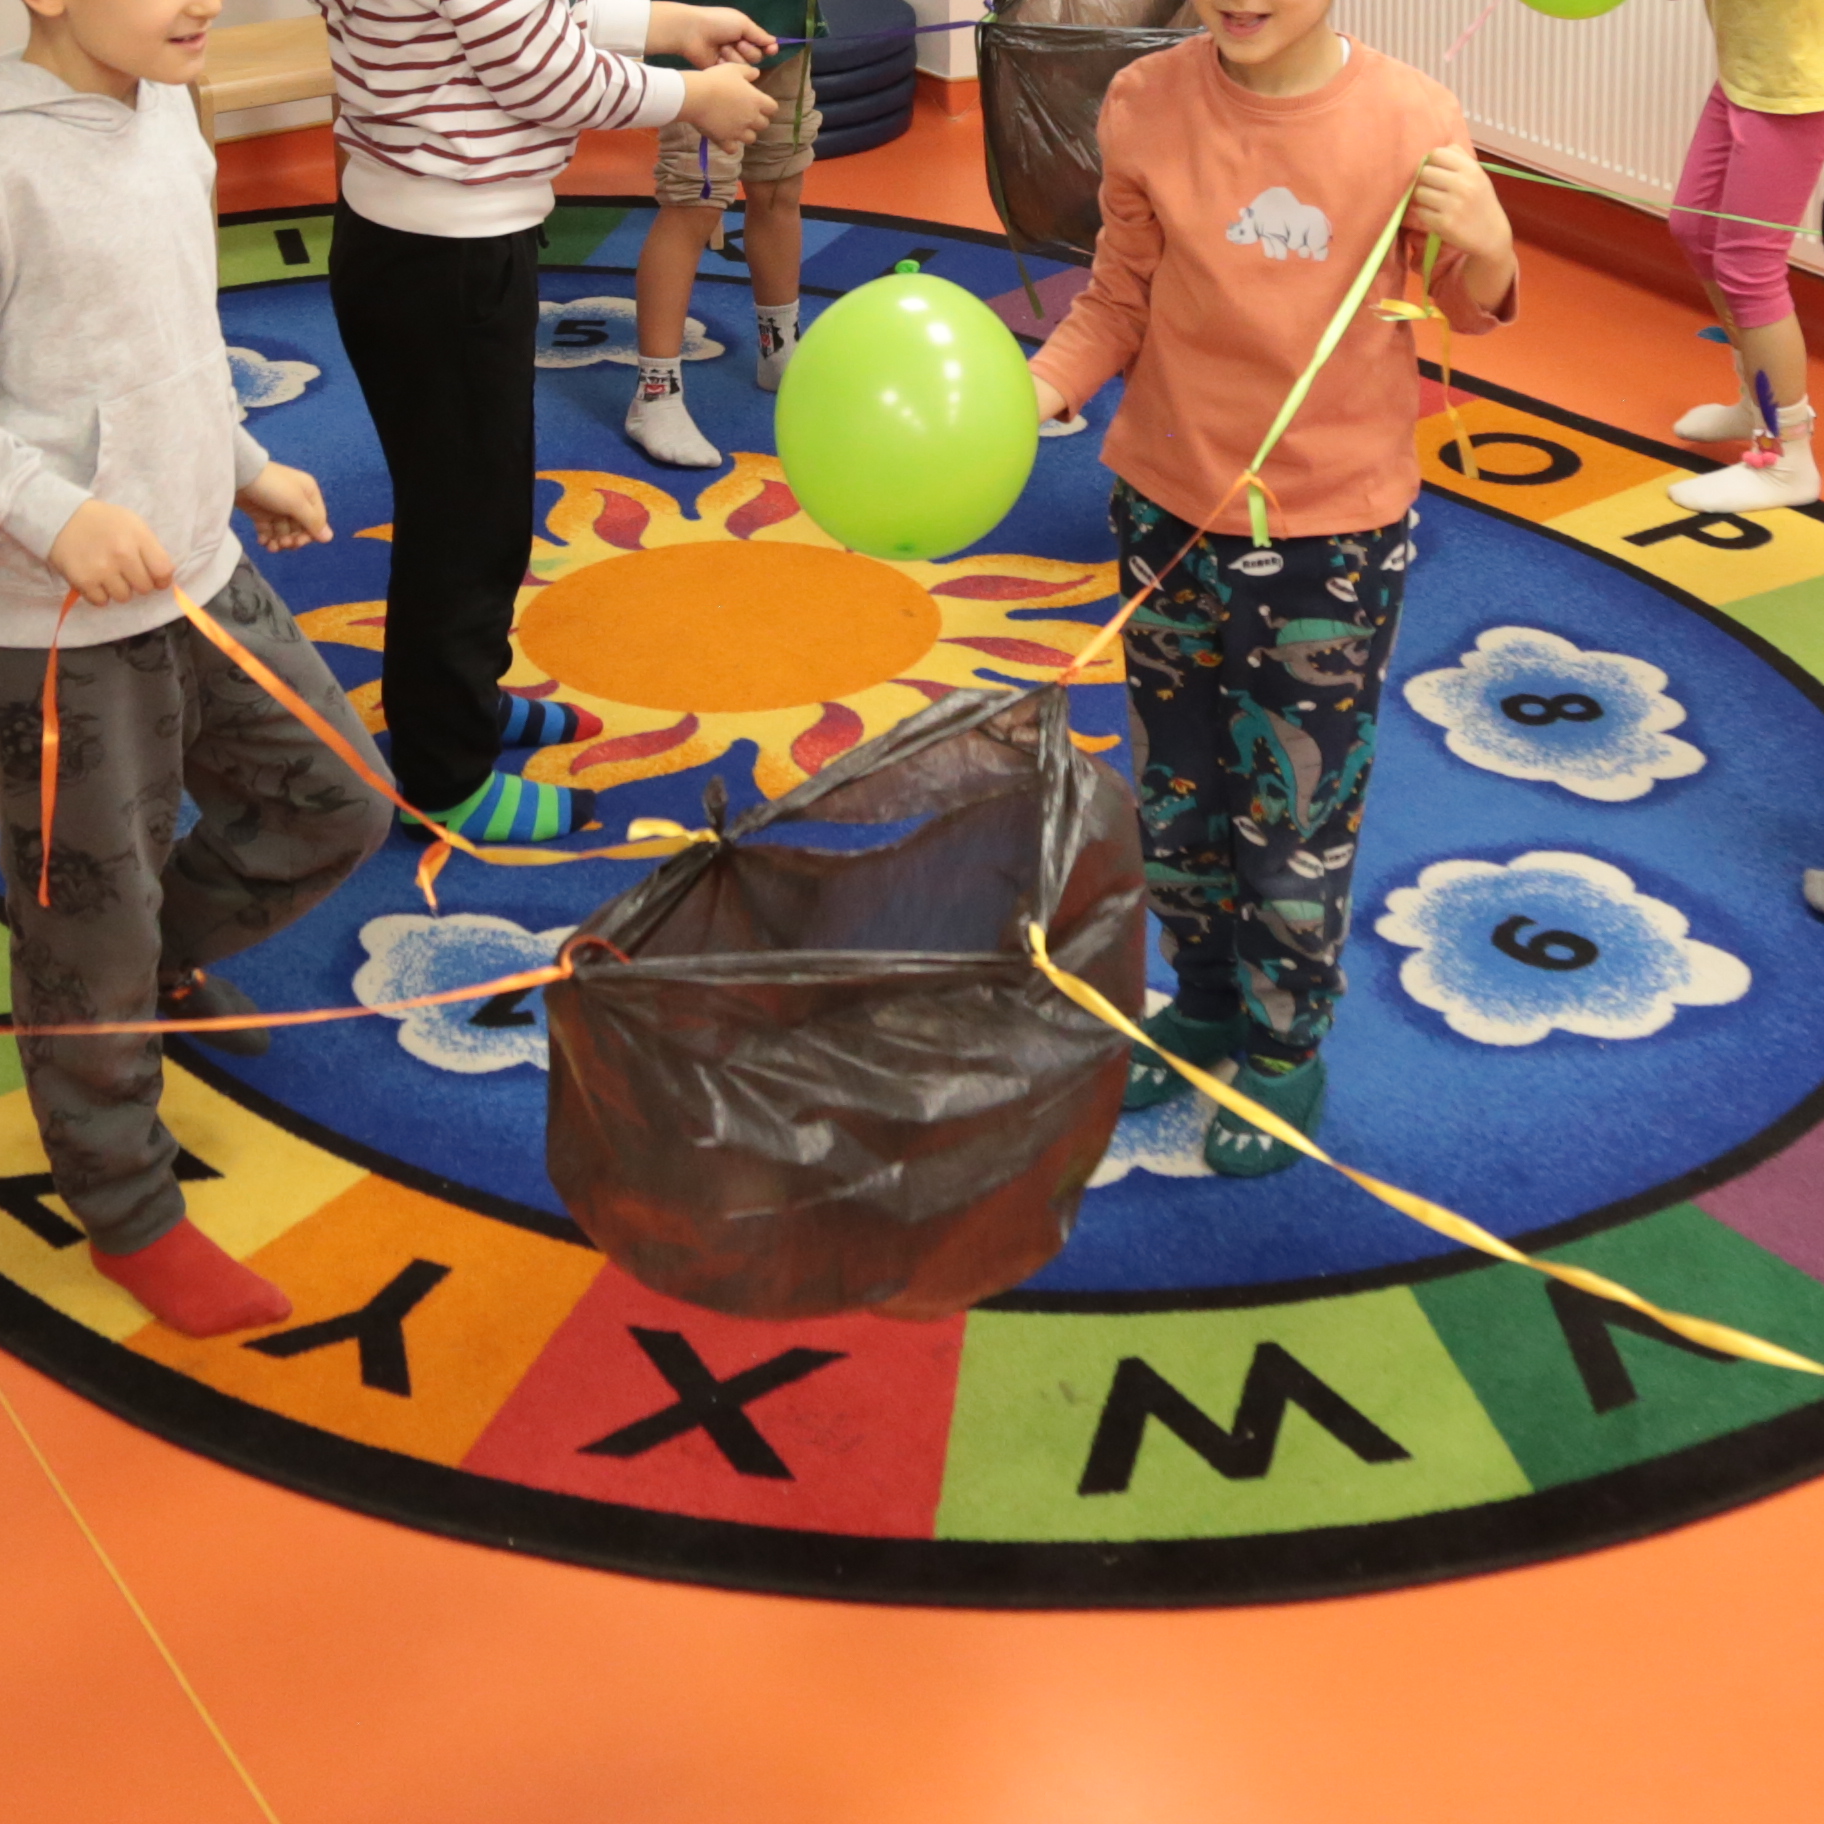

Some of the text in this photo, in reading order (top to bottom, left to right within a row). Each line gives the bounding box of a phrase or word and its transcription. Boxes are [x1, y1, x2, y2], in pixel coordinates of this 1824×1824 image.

[550, 319, 608, 345] 5
[1438, 431, 1582, 486] O
[1621, 511, 1772, 563] P
[1500, 692, 1604, 728] 8
[242, 1258, 453, 1399] Y
[576, 1326, 849, 1481] X
[1077, 1341, 1413, 1497] W
